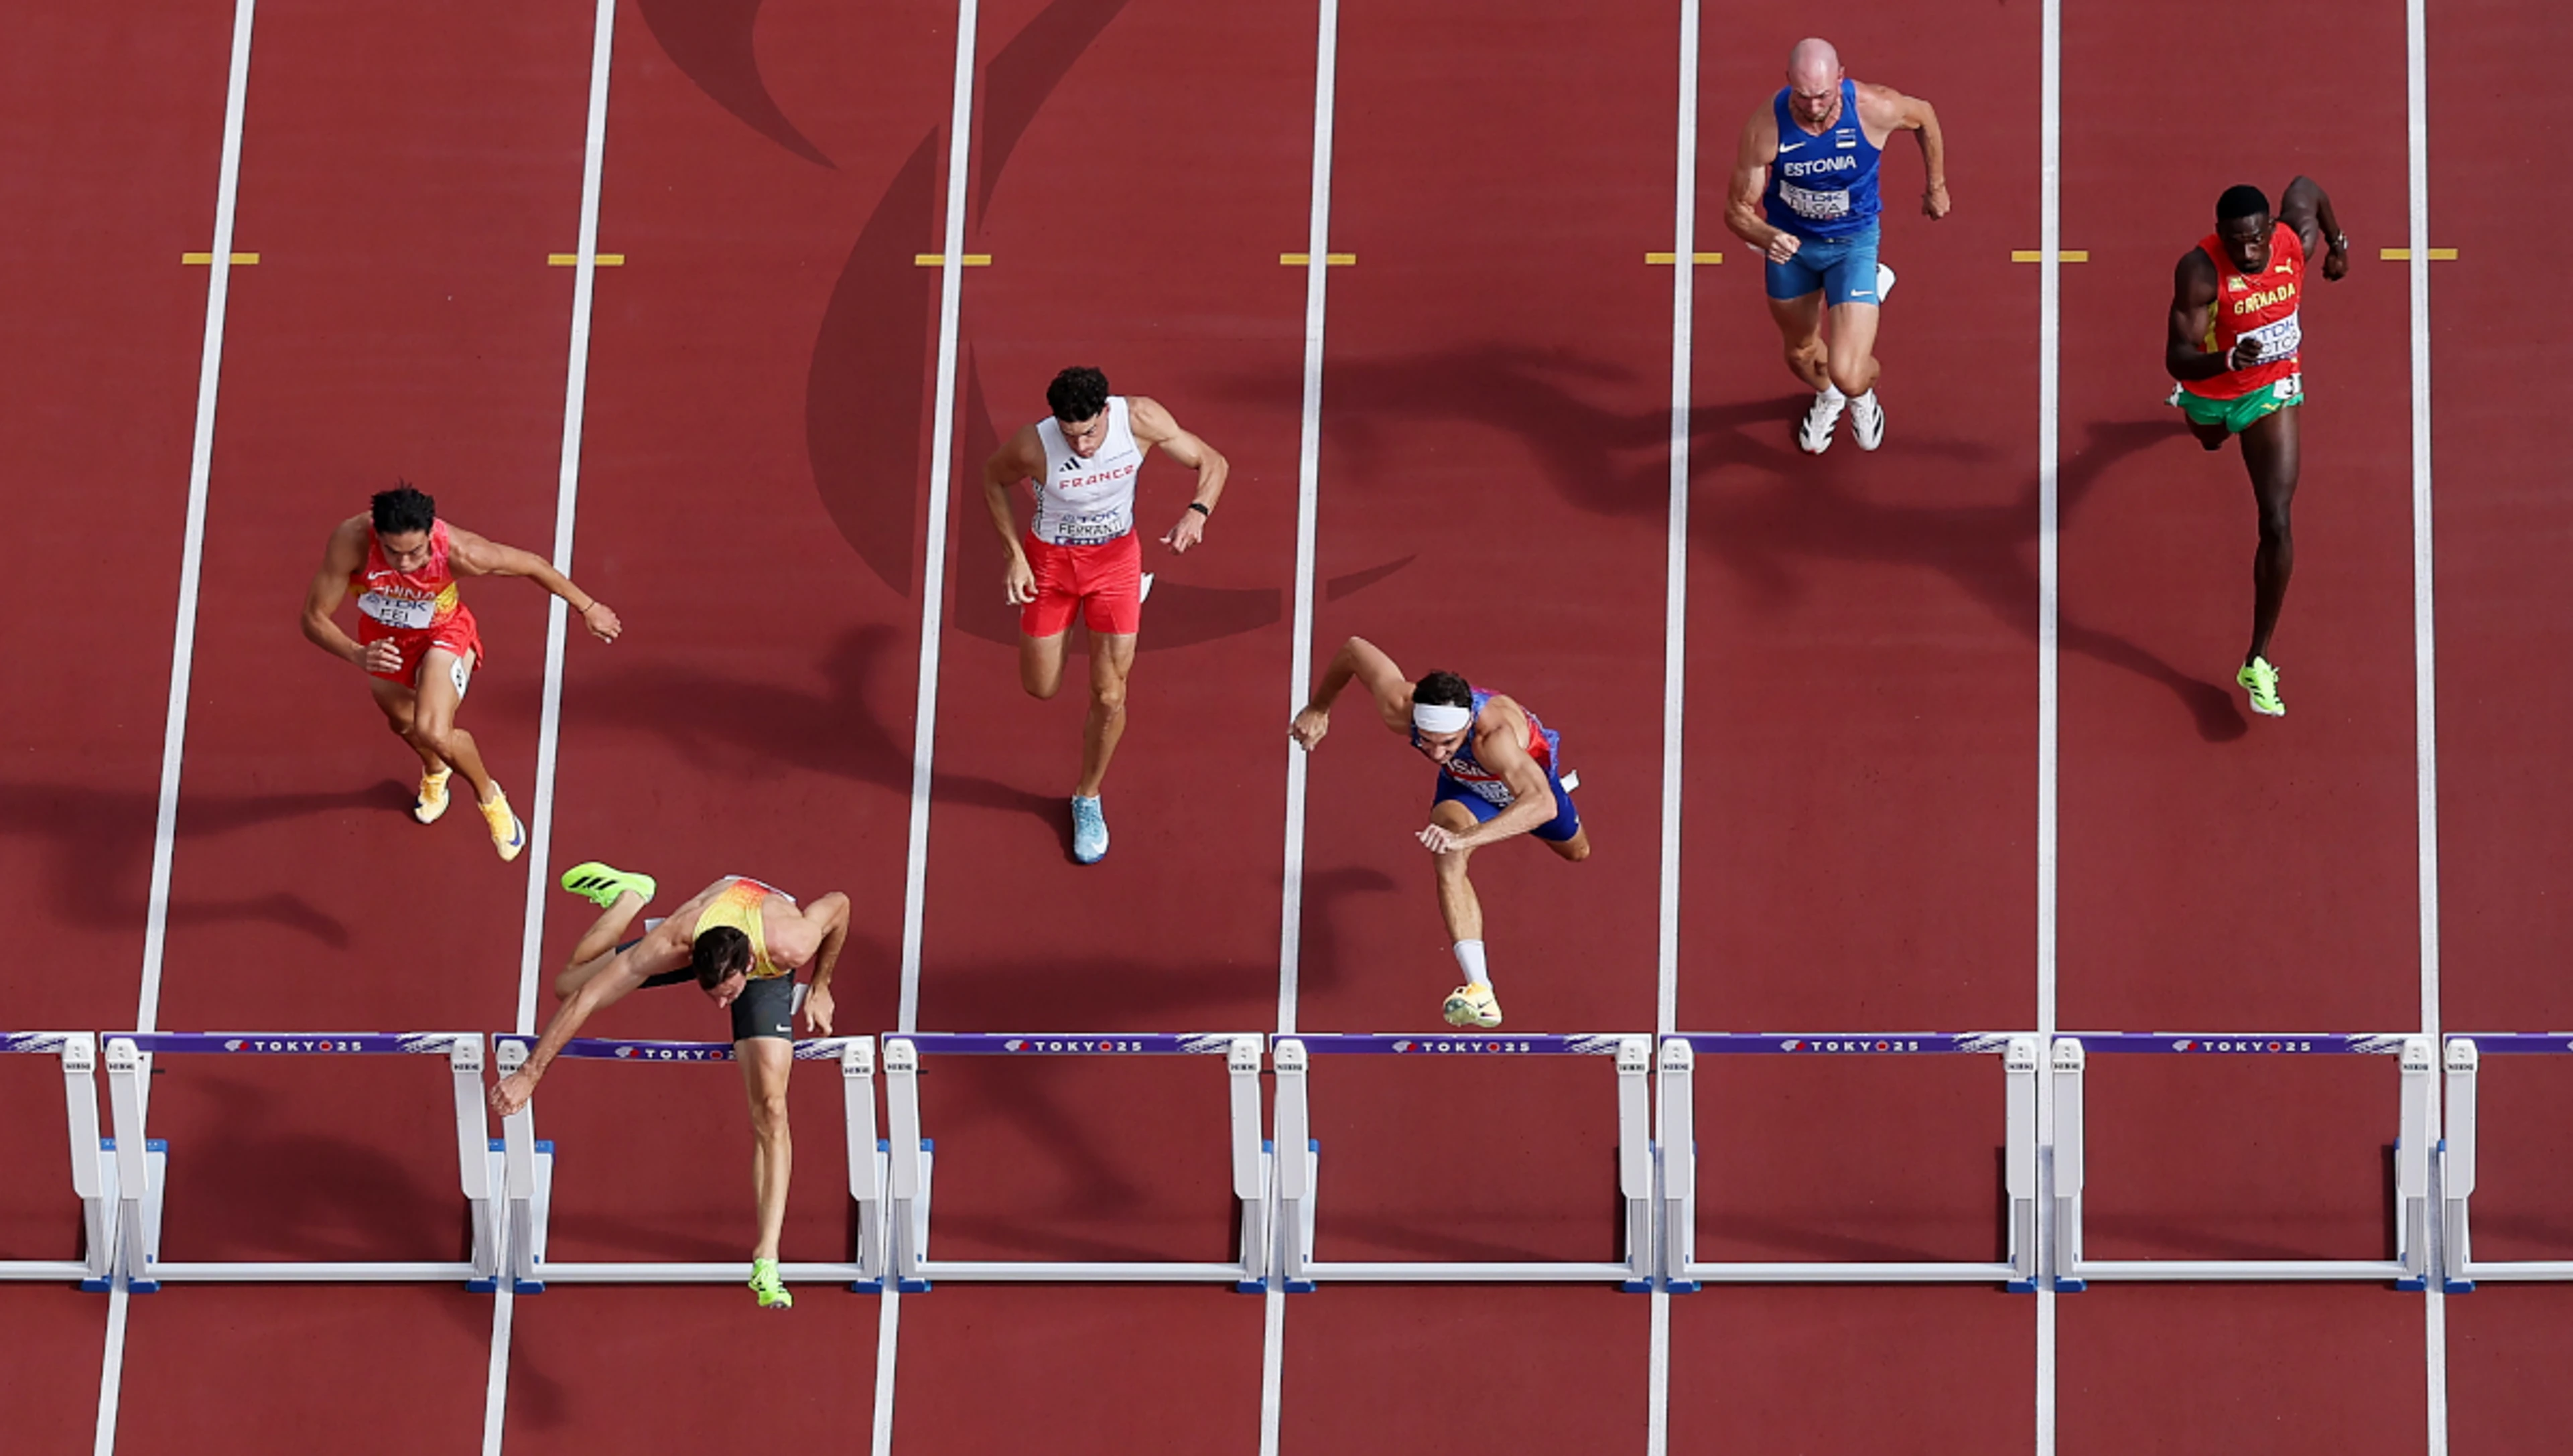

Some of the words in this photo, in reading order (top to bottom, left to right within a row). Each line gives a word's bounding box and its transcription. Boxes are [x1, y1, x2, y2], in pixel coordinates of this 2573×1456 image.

[1784, 155, 1857, 177] ESTONIA
[2233, 282, 2297, 315] GRENADA
[1059, 464, 1135, 490] FRANCE
[379, 608, 409, 623] FEI
[382, 597, 427, 612] TDK
